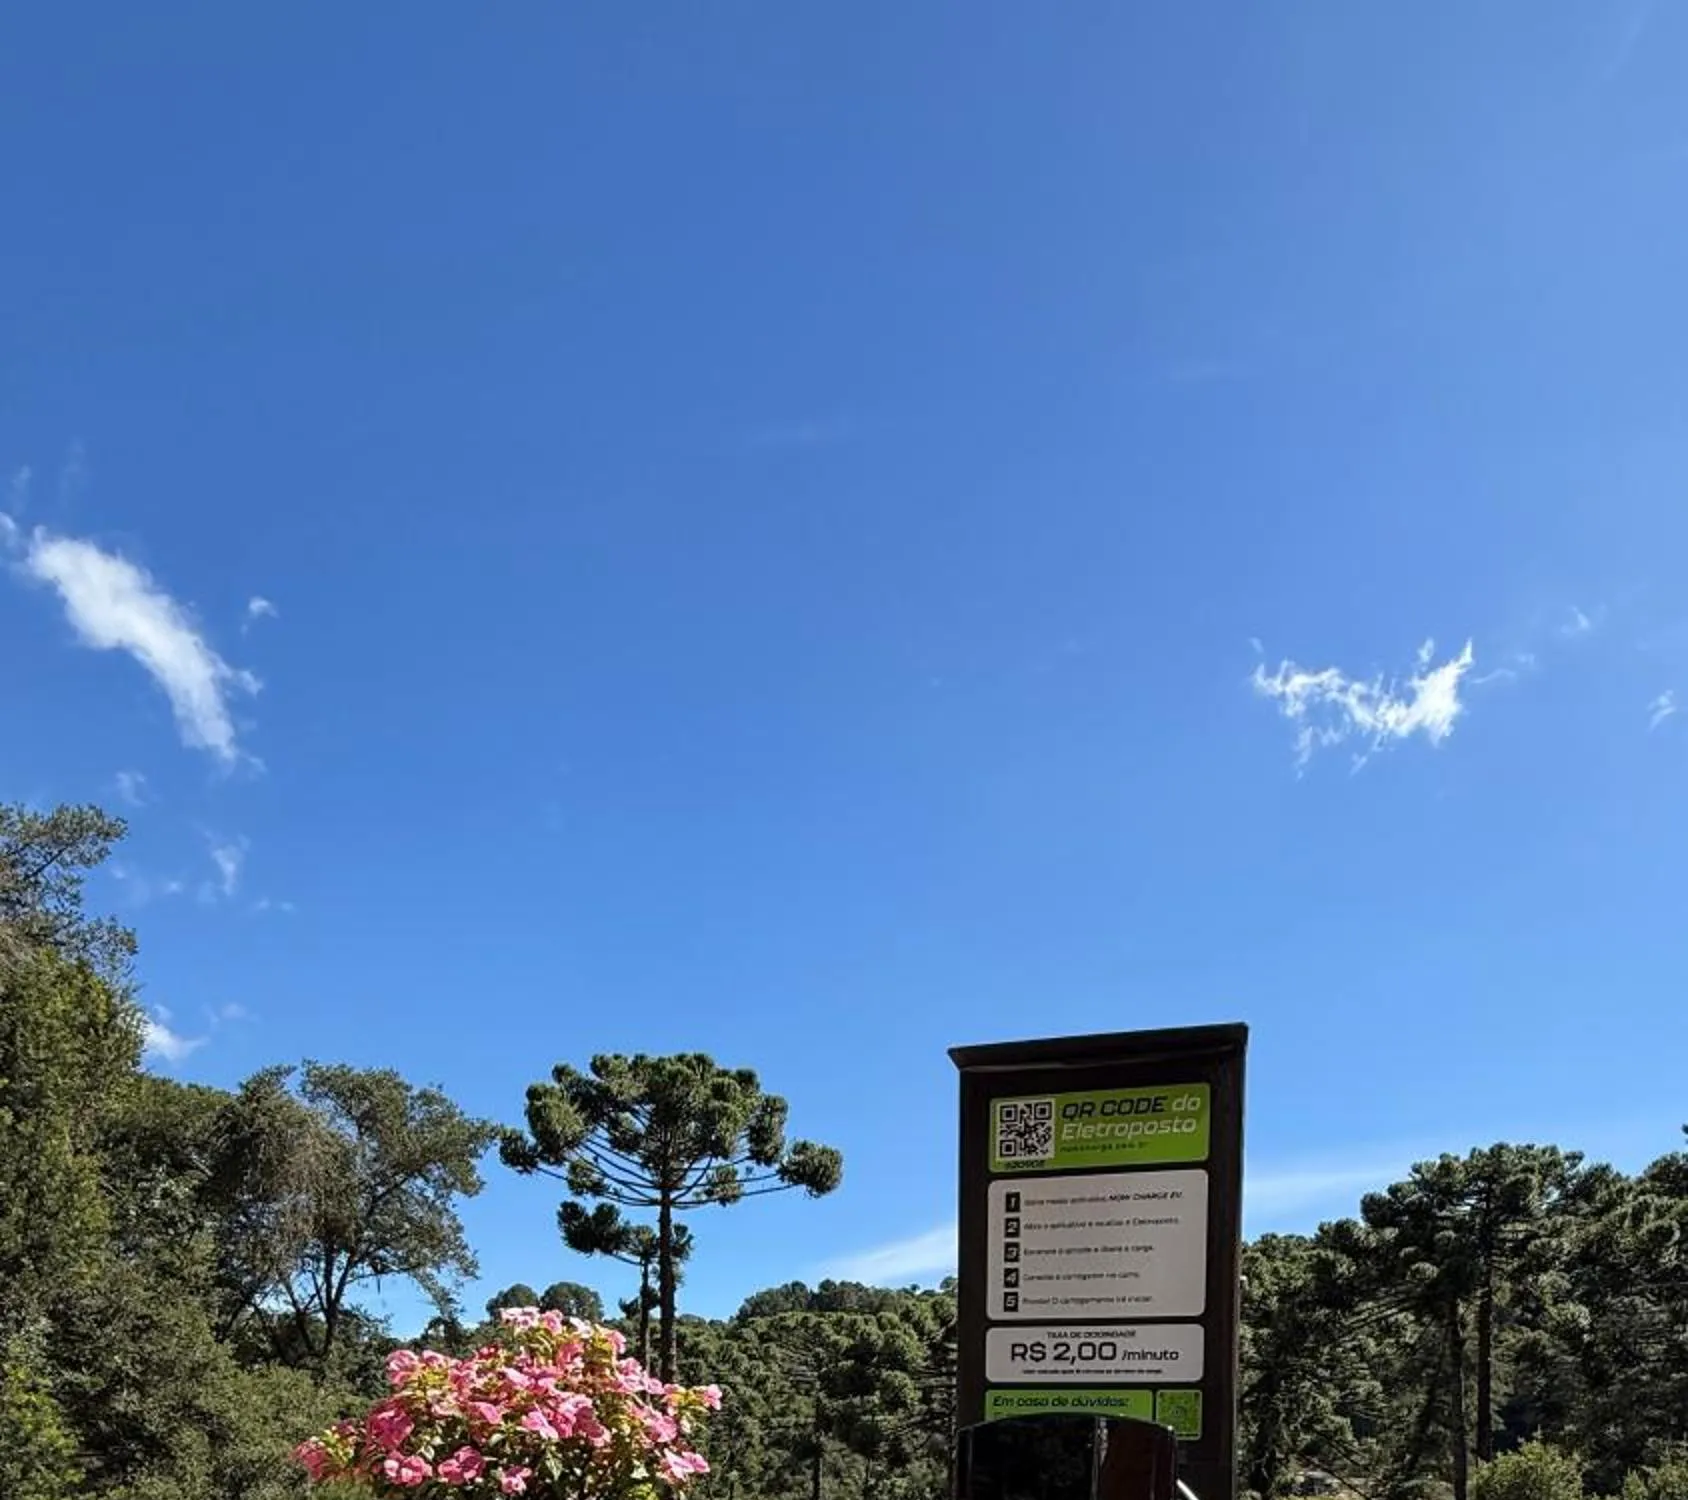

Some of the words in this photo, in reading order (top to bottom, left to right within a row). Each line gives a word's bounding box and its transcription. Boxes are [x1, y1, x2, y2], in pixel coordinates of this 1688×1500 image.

[1061, 1101, 1096, 1121] QR
[1099, 1096, 1168, 1117] CODE
[1171, 1094, 1201, 1112] do
[1061, 1117, 1197, 1140] Eletroposto
[1010, 1341, 1047, 1363] R$
[1052, 1341, 1118, 1365] 2,00
[1121, 1348, 1180, 1362] /minuto
[992, 1395, 1014, 1408] Em
[1017, 1396, 1050, 1408] caso
[1051, 1394, 1070, 1408] de
